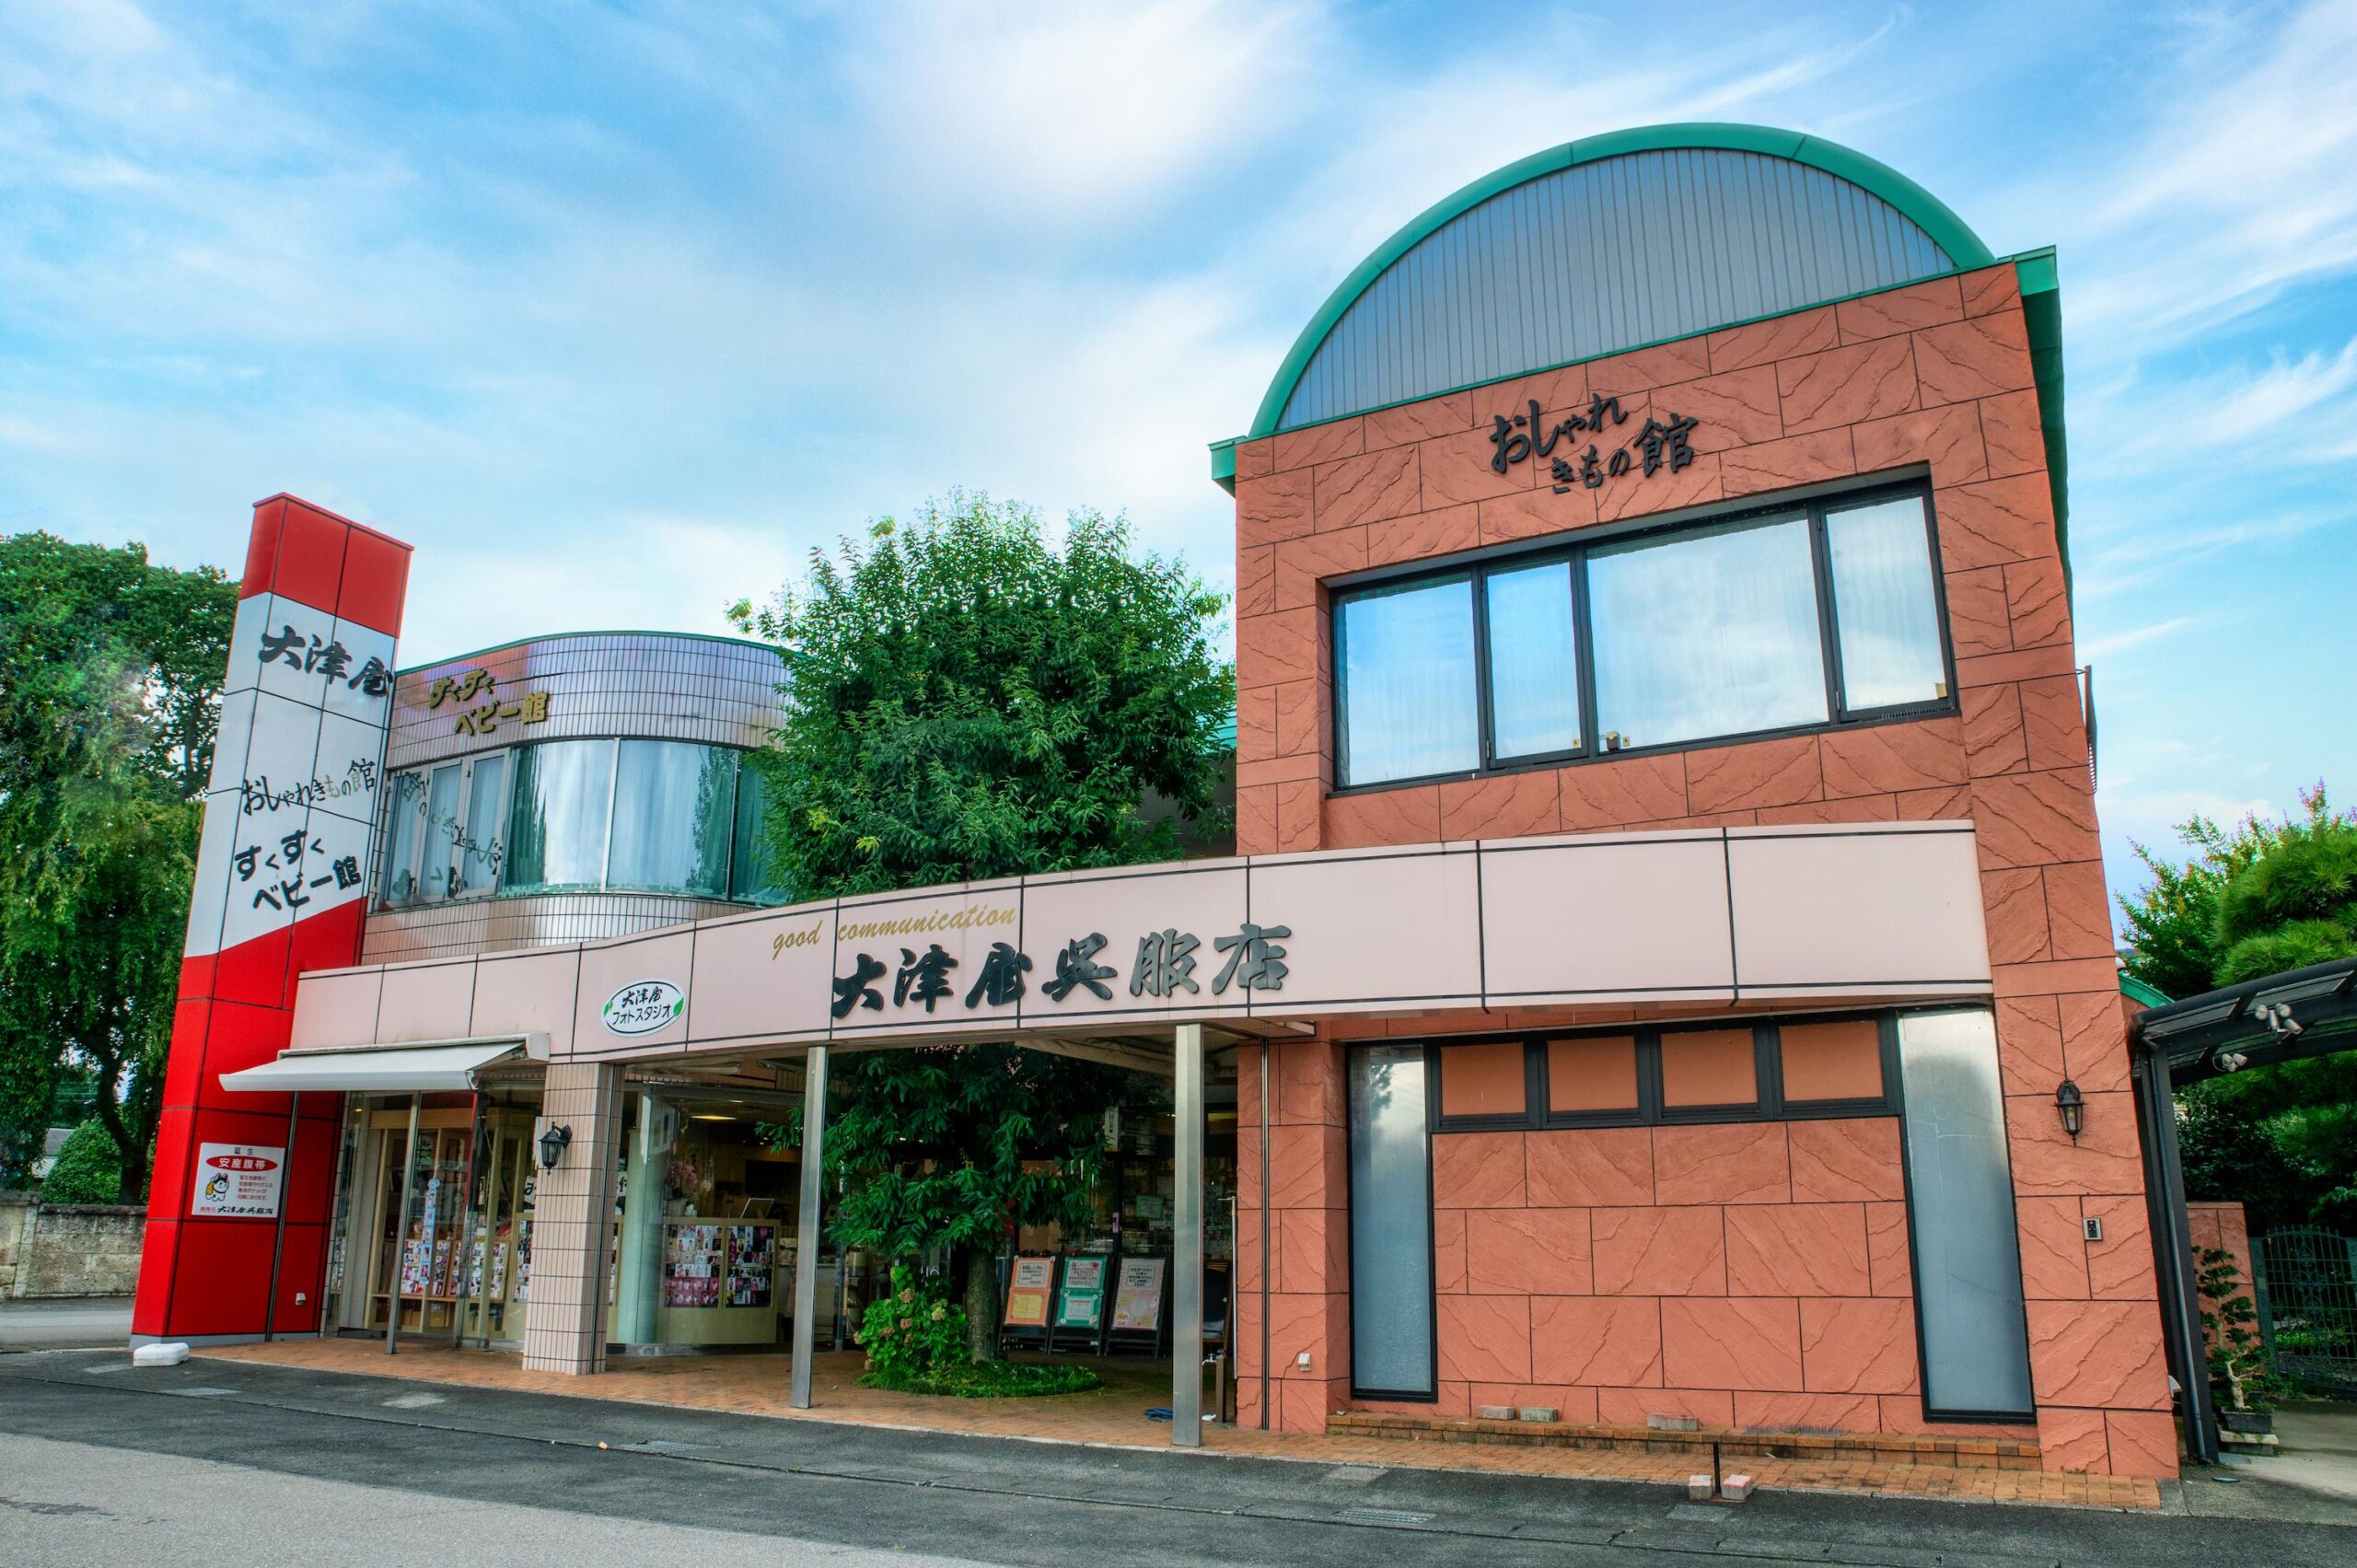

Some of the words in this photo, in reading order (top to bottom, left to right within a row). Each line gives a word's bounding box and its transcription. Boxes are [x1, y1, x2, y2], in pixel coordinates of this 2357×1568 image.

[1489, 393, 1629, 474] おしゃれ
[1552, 413, 1700, 494] きもの館
[259, 625, 394, 697] 大津屋
[429, 668, 494, 709] すくすく
[454, 691, 550, 737] ベビー館
[242, 759, 376, 816] おしゃれきもの館
[234, 830, 325, 881] すくすく
[252, 855, 362, 910] ベビー館
[772, 920, 824, 960] good
[837, 904, 1017, 942] communication
[621, 986, 663, 1008] 大津屋
[832, 923, 1293, 1018] 大津屋呉服店
[612, 1004, 671, 1025] フォトスタジオ
[219, 1157, 266, 1169] 安産腹帯
